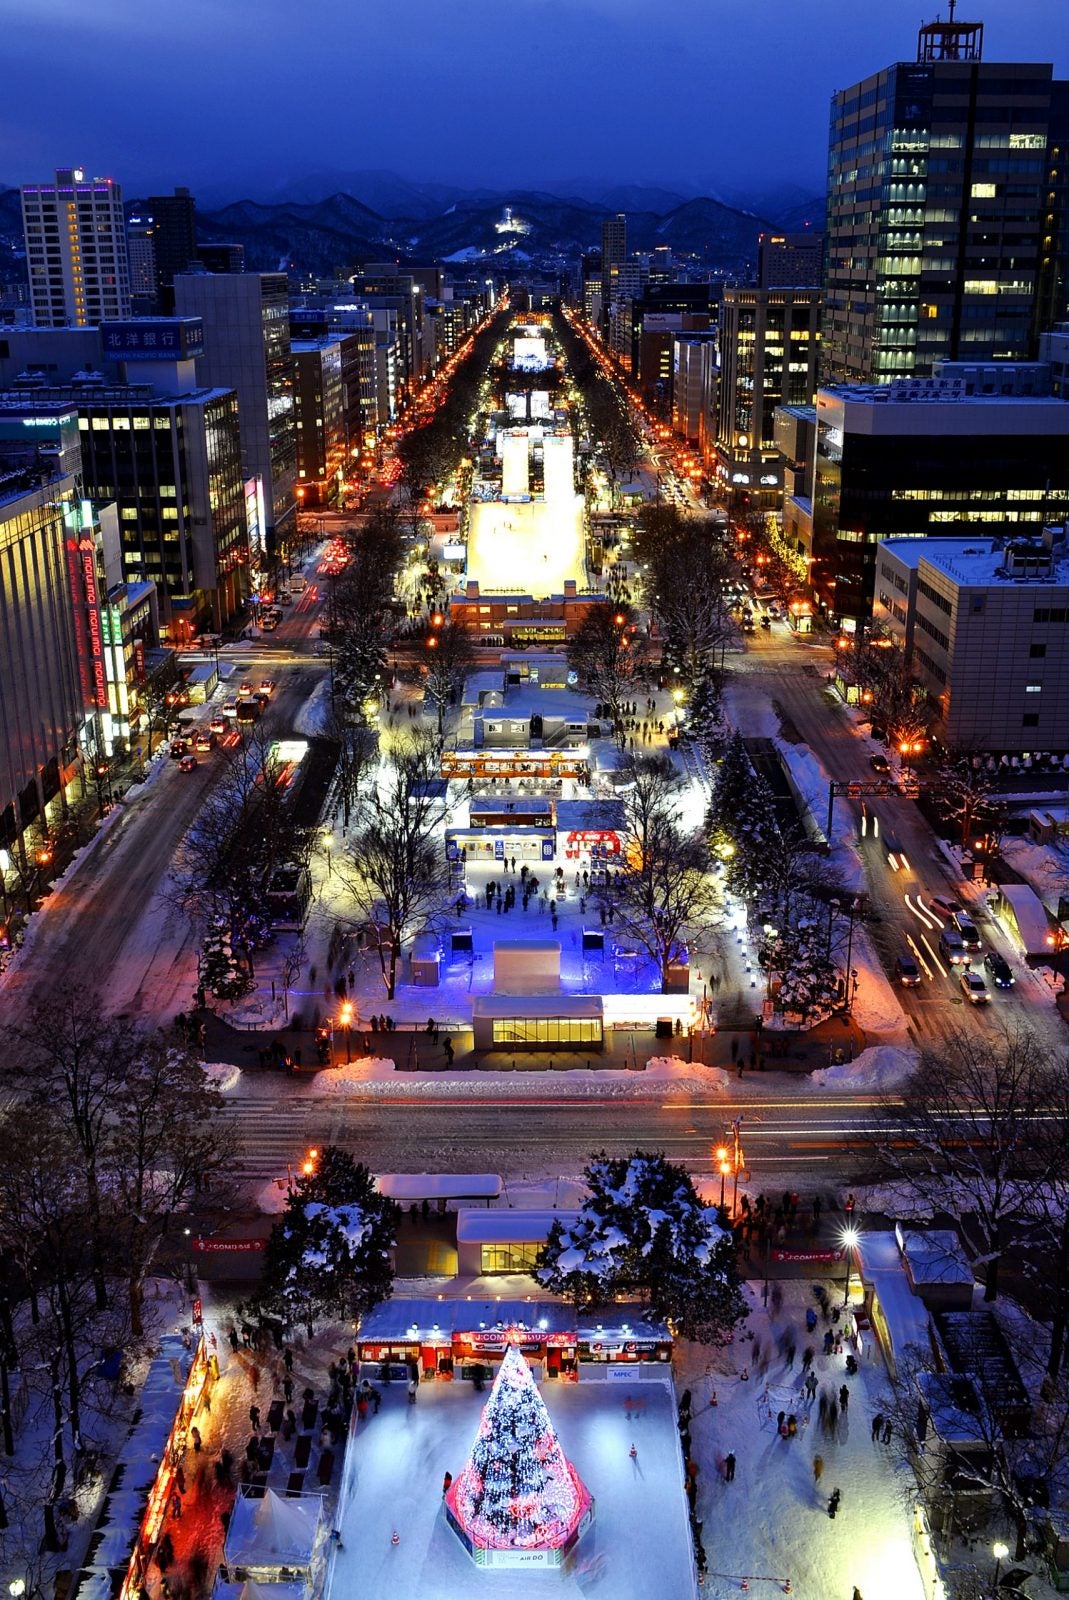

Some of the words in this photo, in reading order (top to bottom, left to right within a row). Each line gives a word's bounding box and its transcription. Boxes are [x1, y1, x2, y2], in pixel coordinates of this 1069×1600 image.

[108, 332, 176, 346] 北洋銀行
[84, 556, 94, 583] marui
[89, 609, 99, 636] marui
[95, 661, 104, 687] marui
